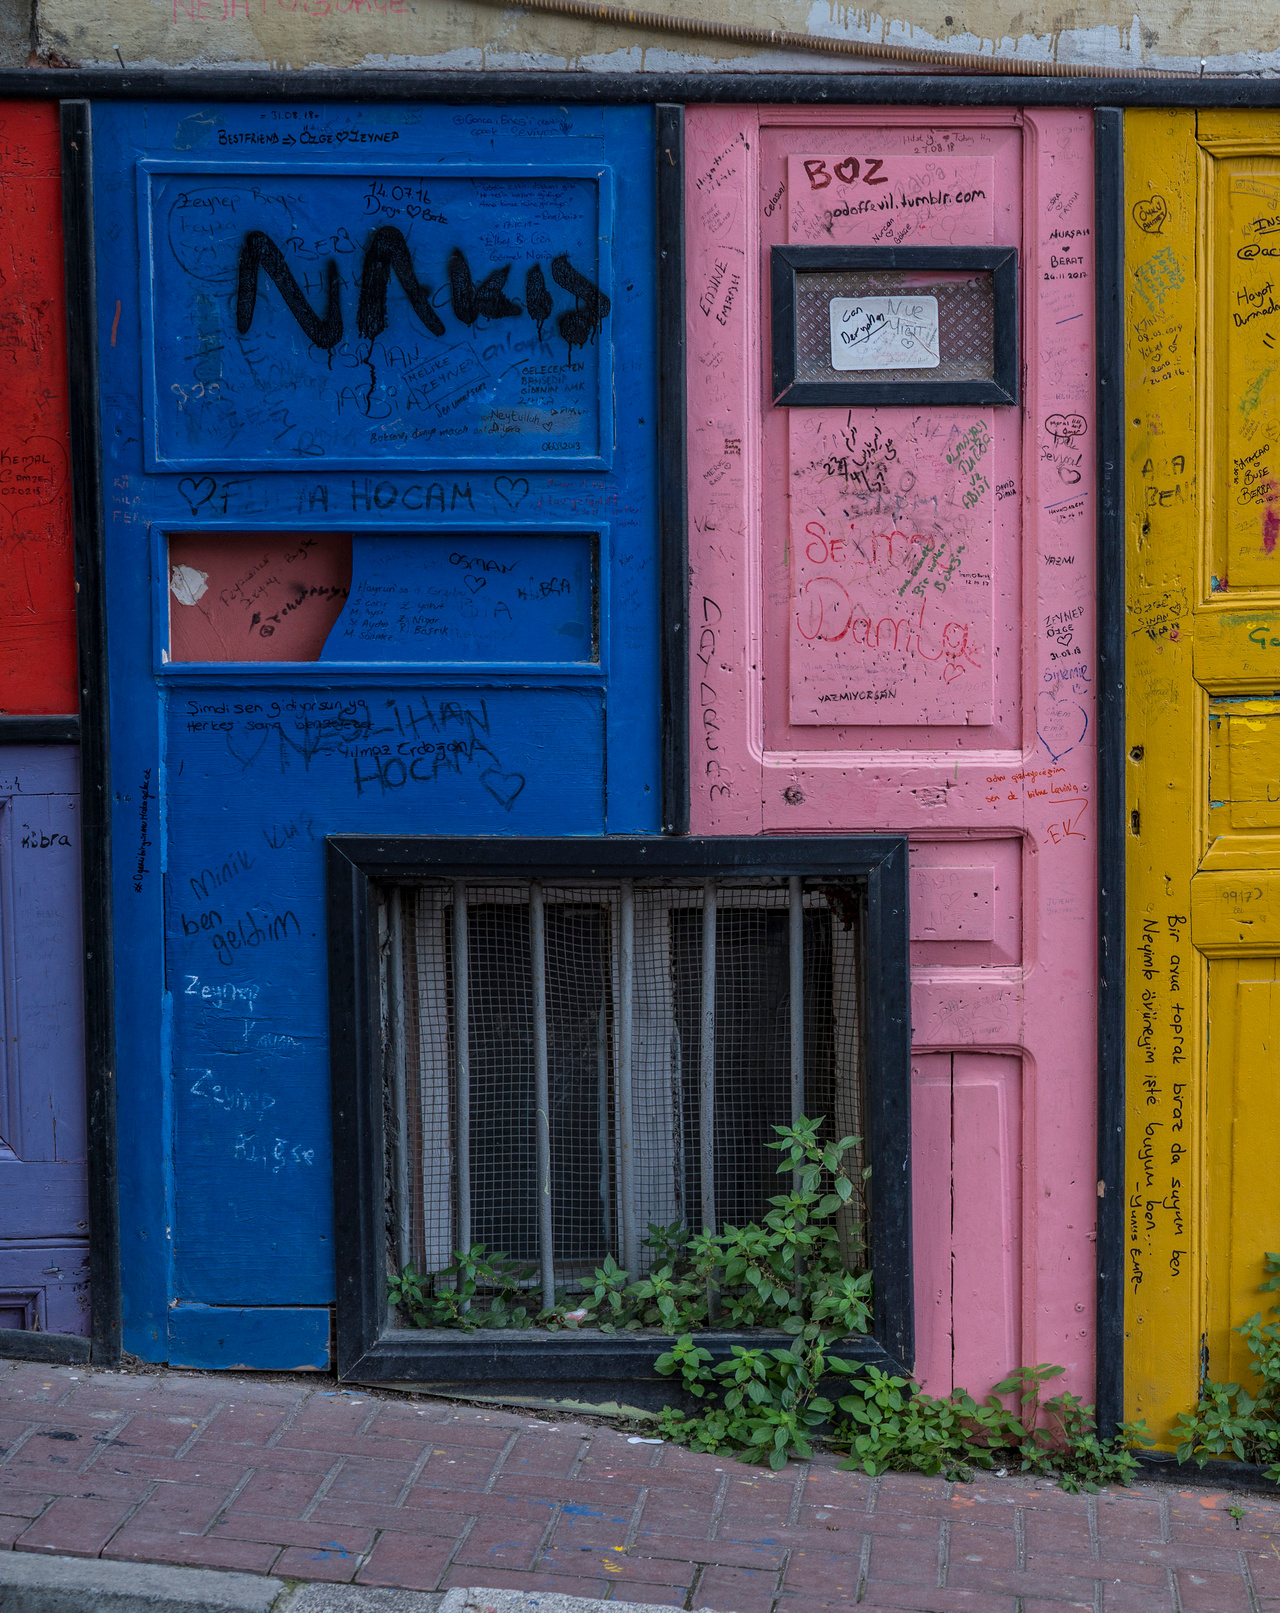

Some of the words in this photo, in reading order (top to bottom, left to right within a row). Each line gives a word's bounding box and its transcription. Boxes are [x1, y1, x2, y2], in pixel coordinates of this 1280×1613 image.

[217, 129, 279, 146] BESTFRIEND
[802, 156, 889, 191] BOZ
[367, 181, 431, 204] 14.07.16
[1050, 254, 1085, 269] BERAT
[1236, 281, 1275, 308] Hayat
[0, 446, 52, 473] KEMAL
[351, 476, 475, 513] HOCAM
[448, 551, 521, 575] OSMAN
[189, 850, 256, 902] Minik
[181, 908, 222, 938] ben
[1167, 914, 1188, 944] Bir
[1168, 1002, 1188, 1066] toprak
[1171, 1082, 1188, 1133] biraz
[1170, 1142, 1187, 1166] da
[1169, 1248, 1188, 1278] ben
